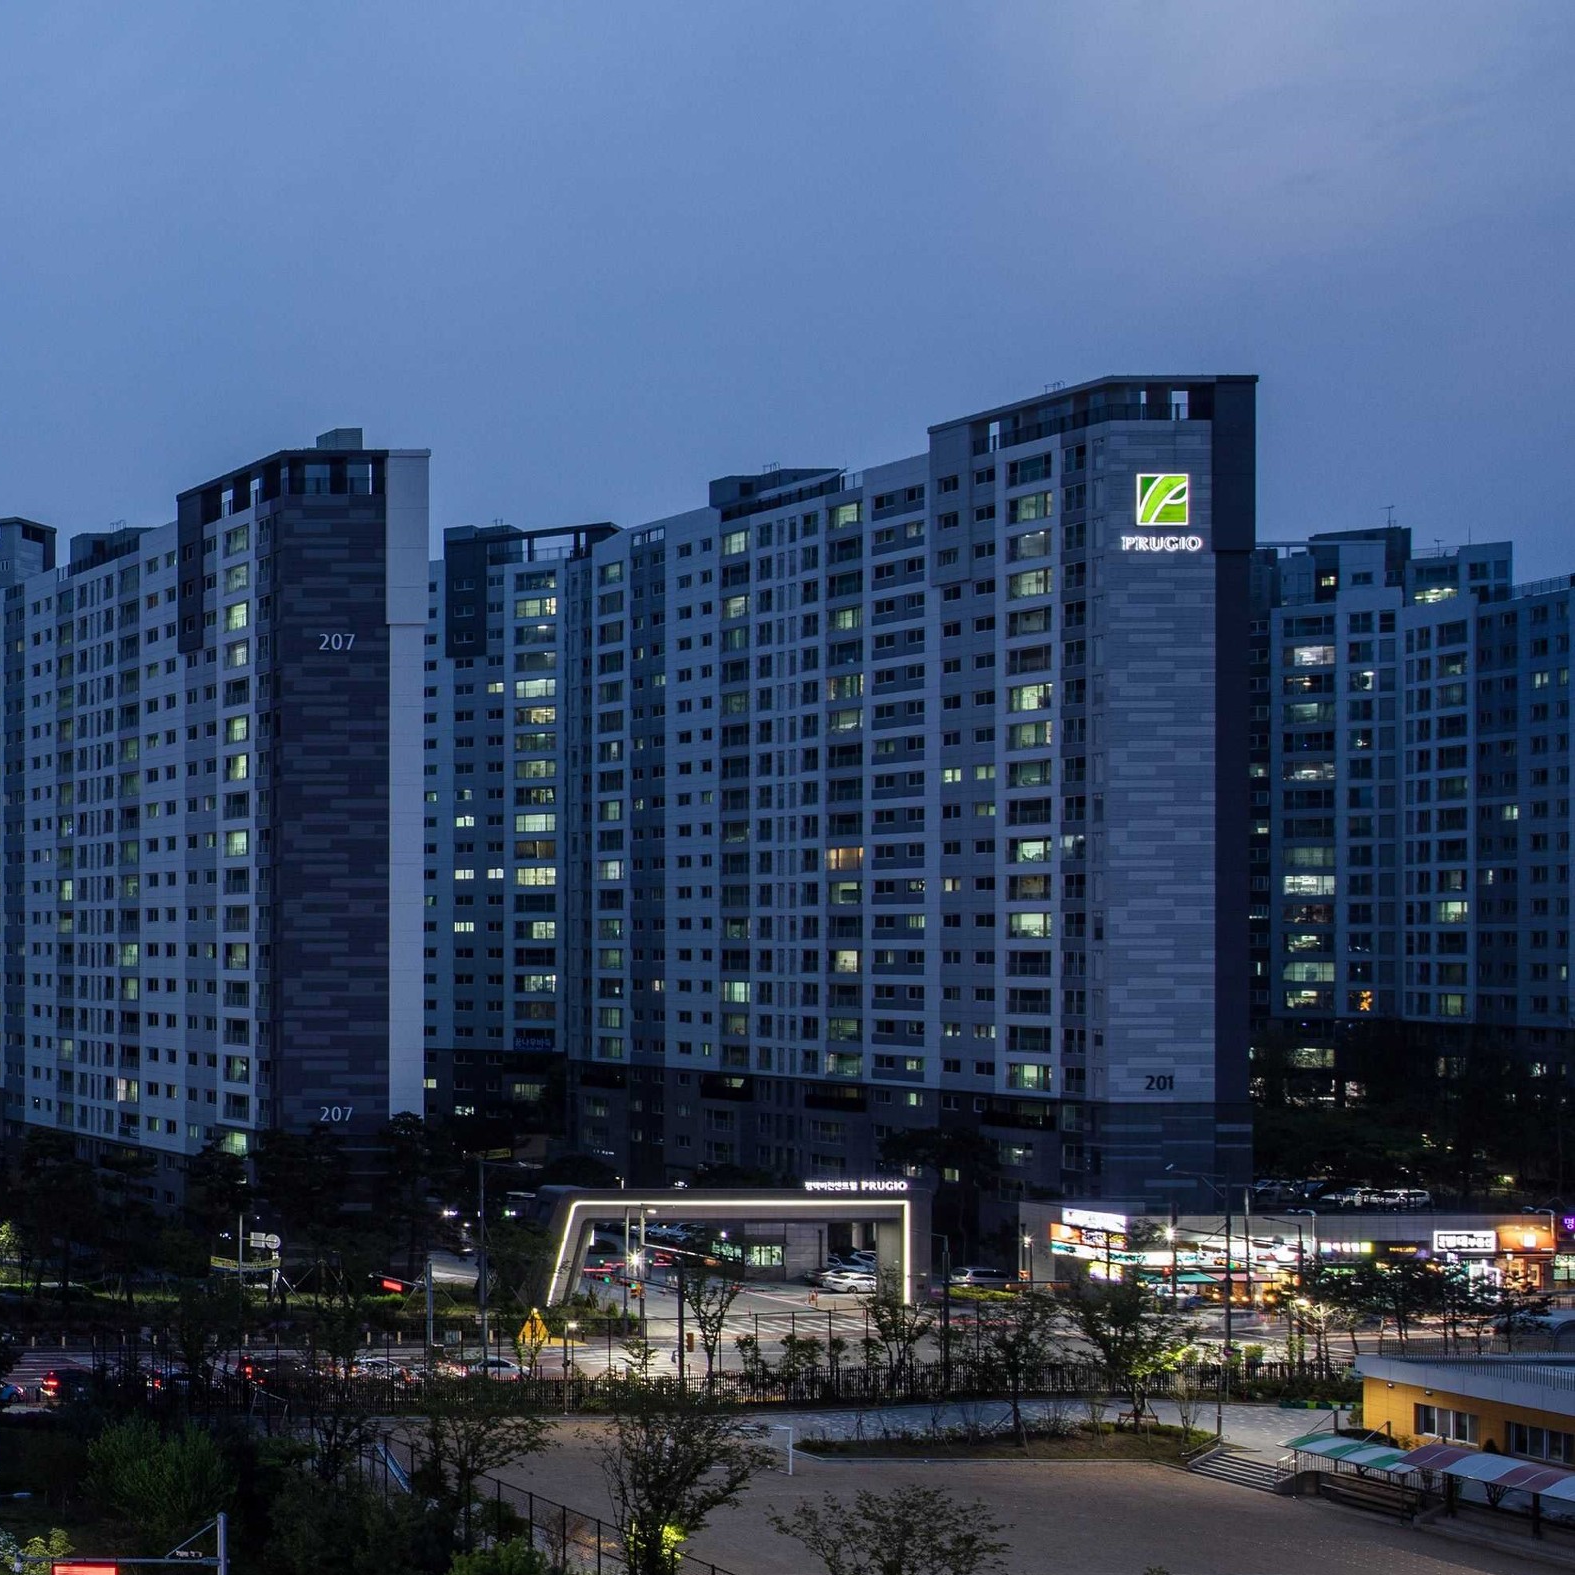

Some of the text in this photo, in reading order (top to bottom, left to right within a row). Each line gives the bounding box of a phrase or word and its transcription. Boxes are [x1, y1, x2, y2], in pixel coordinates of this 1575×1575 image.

[1121, 536, 1203, 551] PRUGIO
[319, 633, 355, 650] 207
[1145, 1075, 1175, 1091] 201
[320, 1106, 353, 1122] 207
[861, 1181, 908, 1191] PRUGIO
